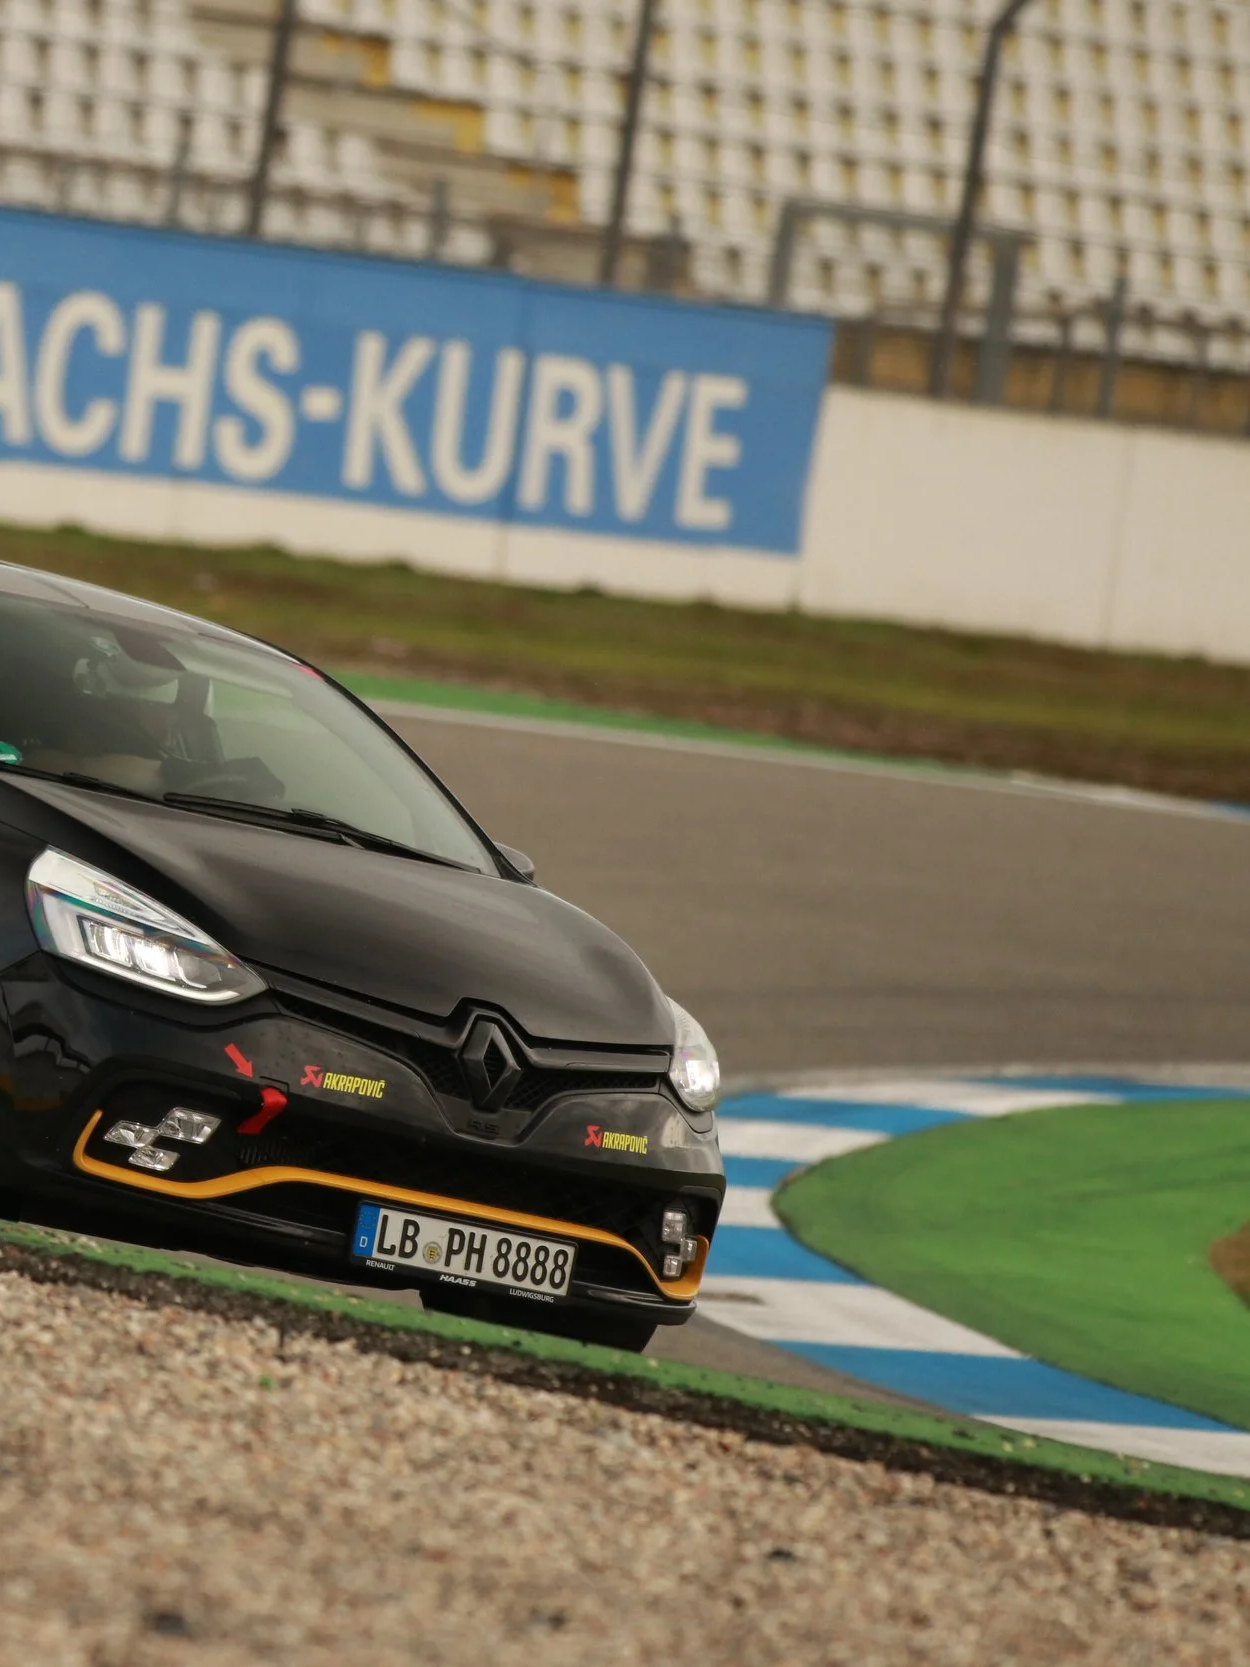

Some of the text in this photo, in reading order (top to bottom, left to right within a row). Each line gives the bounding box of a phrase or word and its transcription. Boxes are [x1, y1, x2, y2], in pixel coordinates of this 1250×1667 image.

[359, 1236, 368, 1248] D
[377, 1214, 569, 1290] LB PH 8888
[365, 1259, 396, 1271] RENAULT
[439, 1274, 477, 1287] HAASS
[509, 1288, 554, 1303] LUDWIGSBURG
